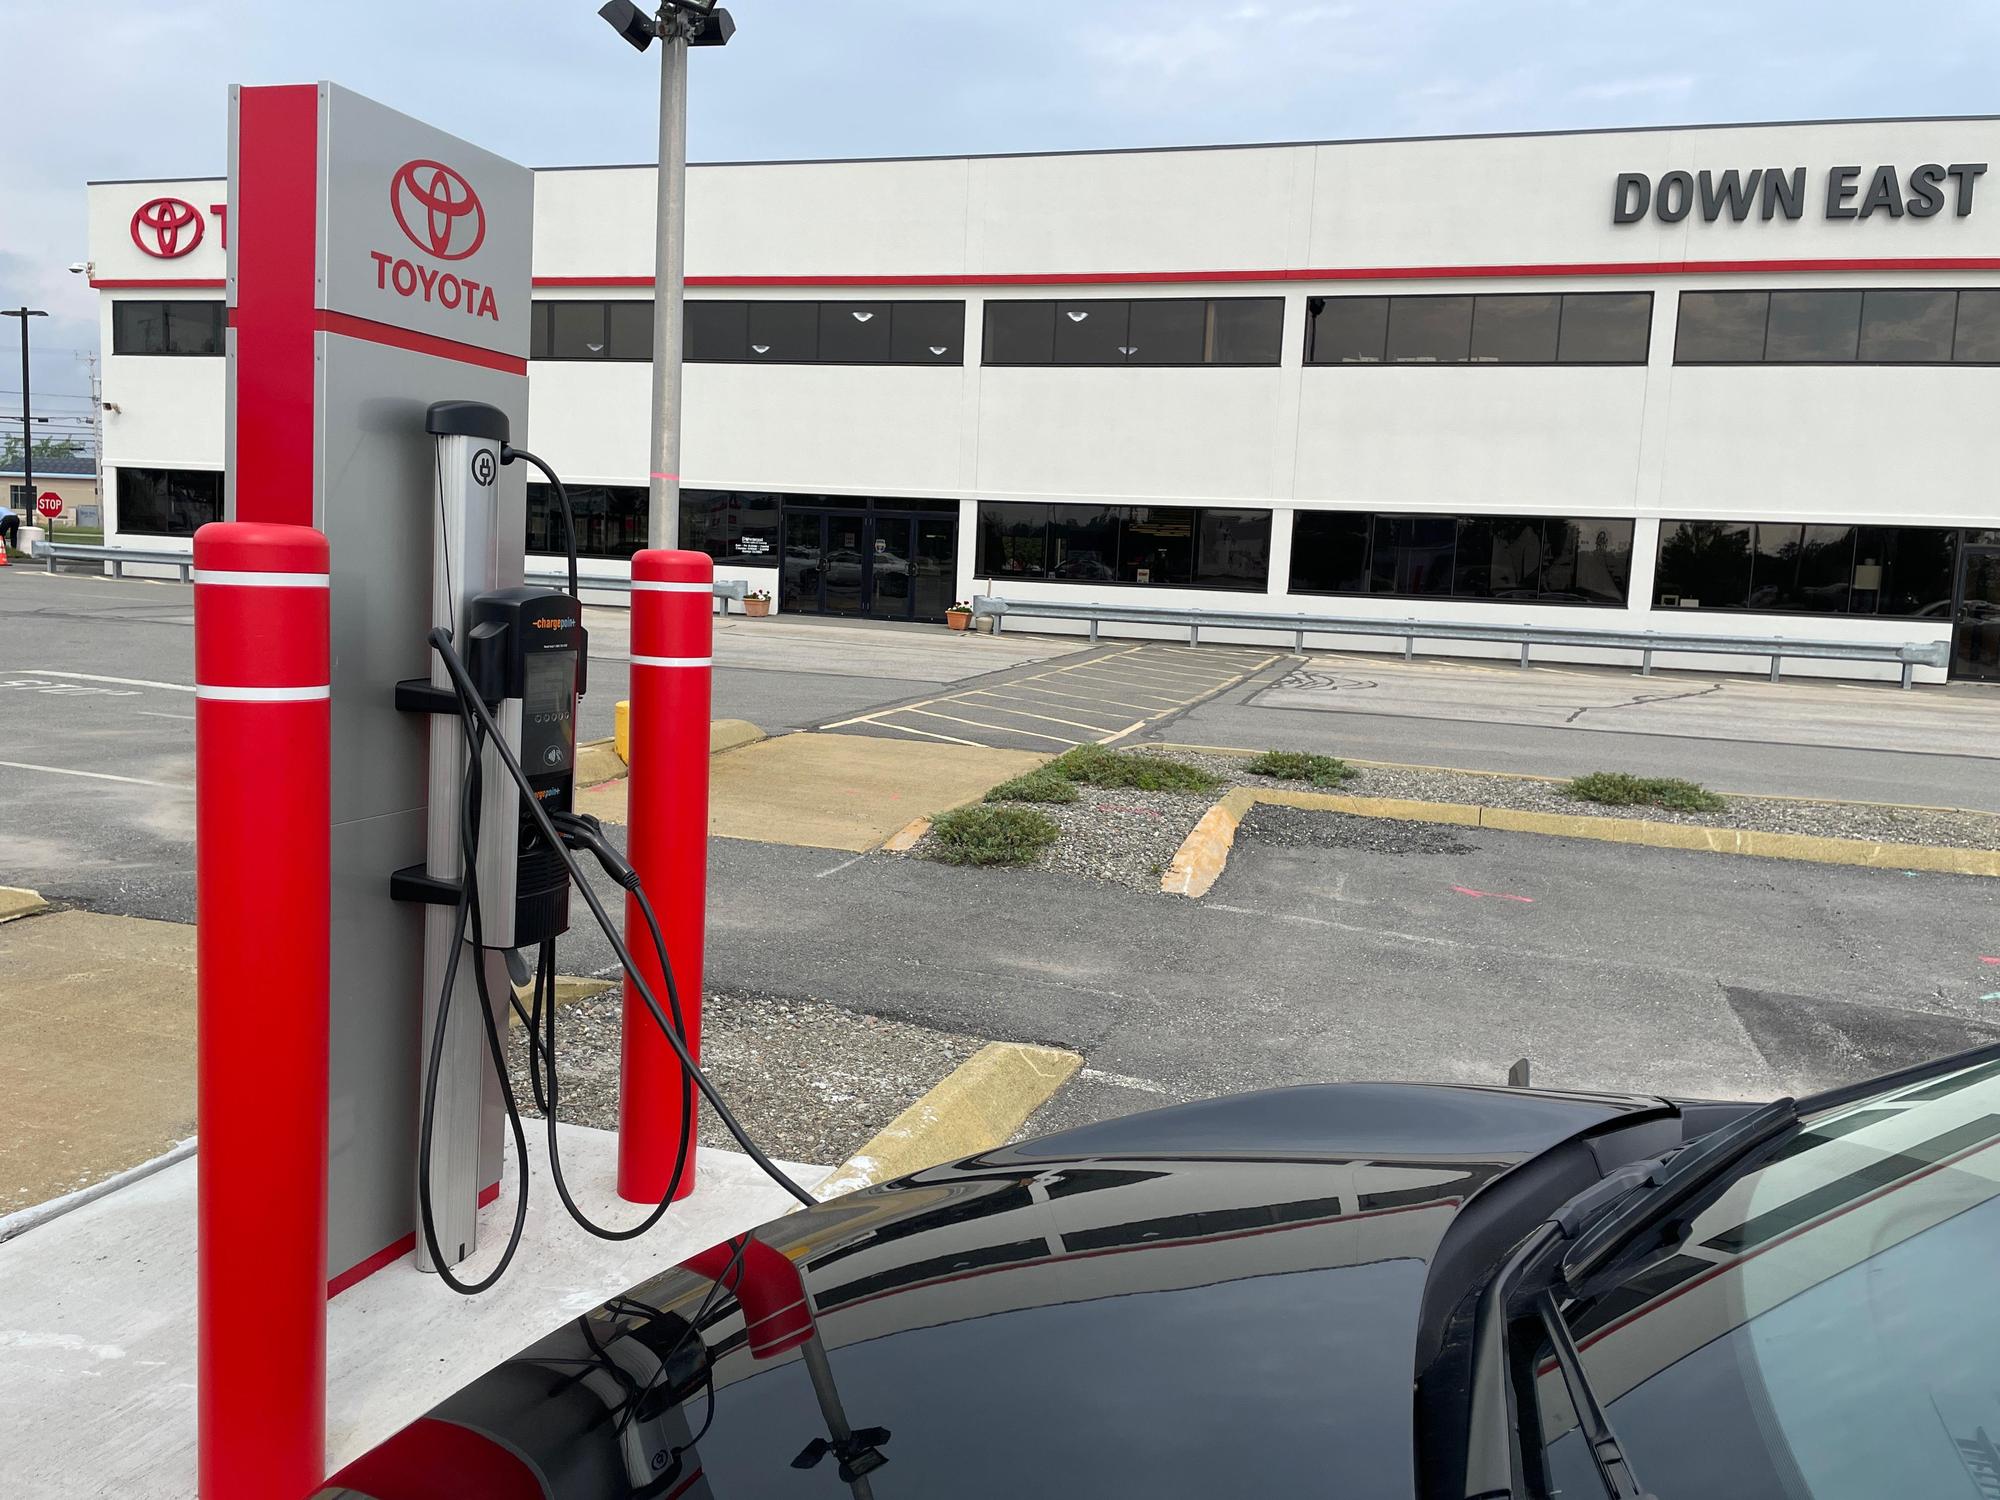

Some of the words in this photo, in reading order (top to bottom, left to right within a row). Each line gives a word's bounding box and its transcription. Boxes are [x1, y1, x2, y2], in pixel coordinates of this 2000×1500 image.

[1613, 166, 1807, 224] DOWN
[1825, 163, 1988, 219] EAST
[370, 250, 500, 322] TOYOTA
[39, 498, 61, 510] STOP
